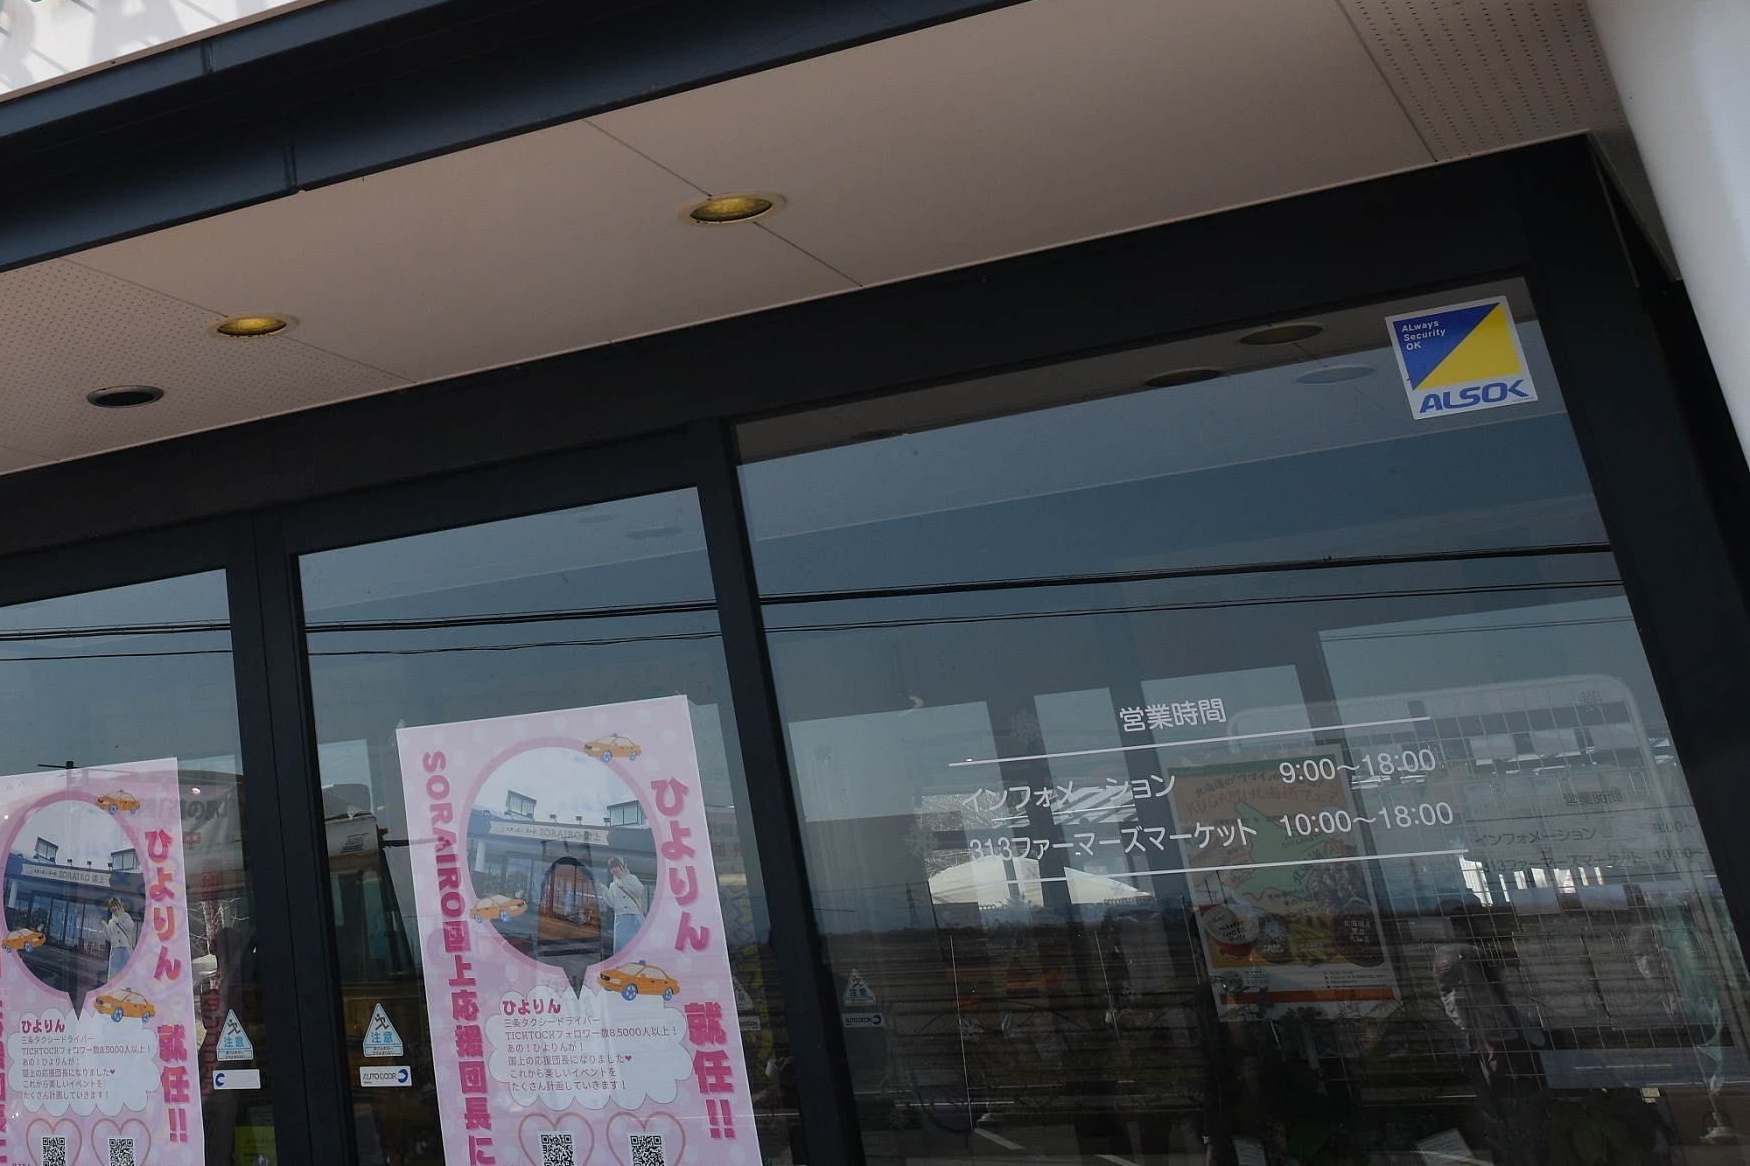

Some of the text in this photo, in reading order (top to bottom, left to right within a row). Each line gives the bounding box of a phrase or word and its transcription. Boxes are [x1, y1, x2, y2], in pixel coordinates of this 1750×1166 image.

[1403, 328, 1446, 342] Security
[1406, 341, 1422, 351] OK
[1419, 379, 1530, 413] ALSOK
[1118, 697, 1228, 732] 営業時間
[962, 773, 1177, 812] インフォメーション
[969, 817, 1258, 862] 313ファーマーズマーケット
[650, 776, 710, 954] ひよりん
[144, 827, 182, 982] ひよりん
[502, 998, 561, 1016] ひよりん
[21, 1019, 66, 1034] ひよりん
[371, 1031, 393, 1043] 注意
[224, 1036, 245, 1048] 注意
